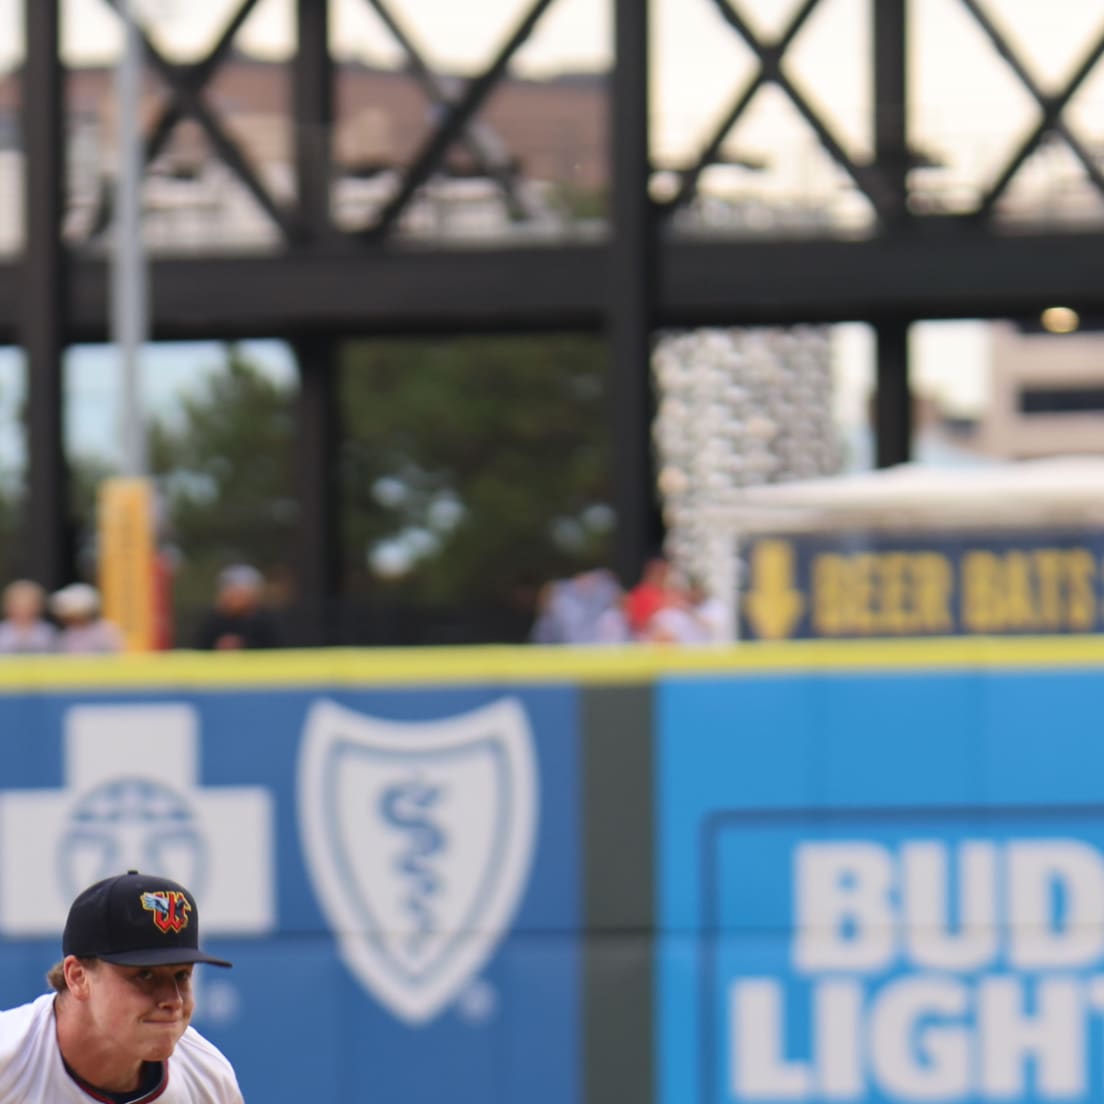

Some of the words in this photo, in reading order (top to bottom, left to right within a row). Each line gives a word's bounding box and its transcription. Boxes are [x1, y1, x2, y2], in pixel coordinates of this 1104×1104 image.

[809, 552, 953, 634] BEER
[961, 549, 1094, 631] BATS
[792, 839, 1104, 971] BUD
